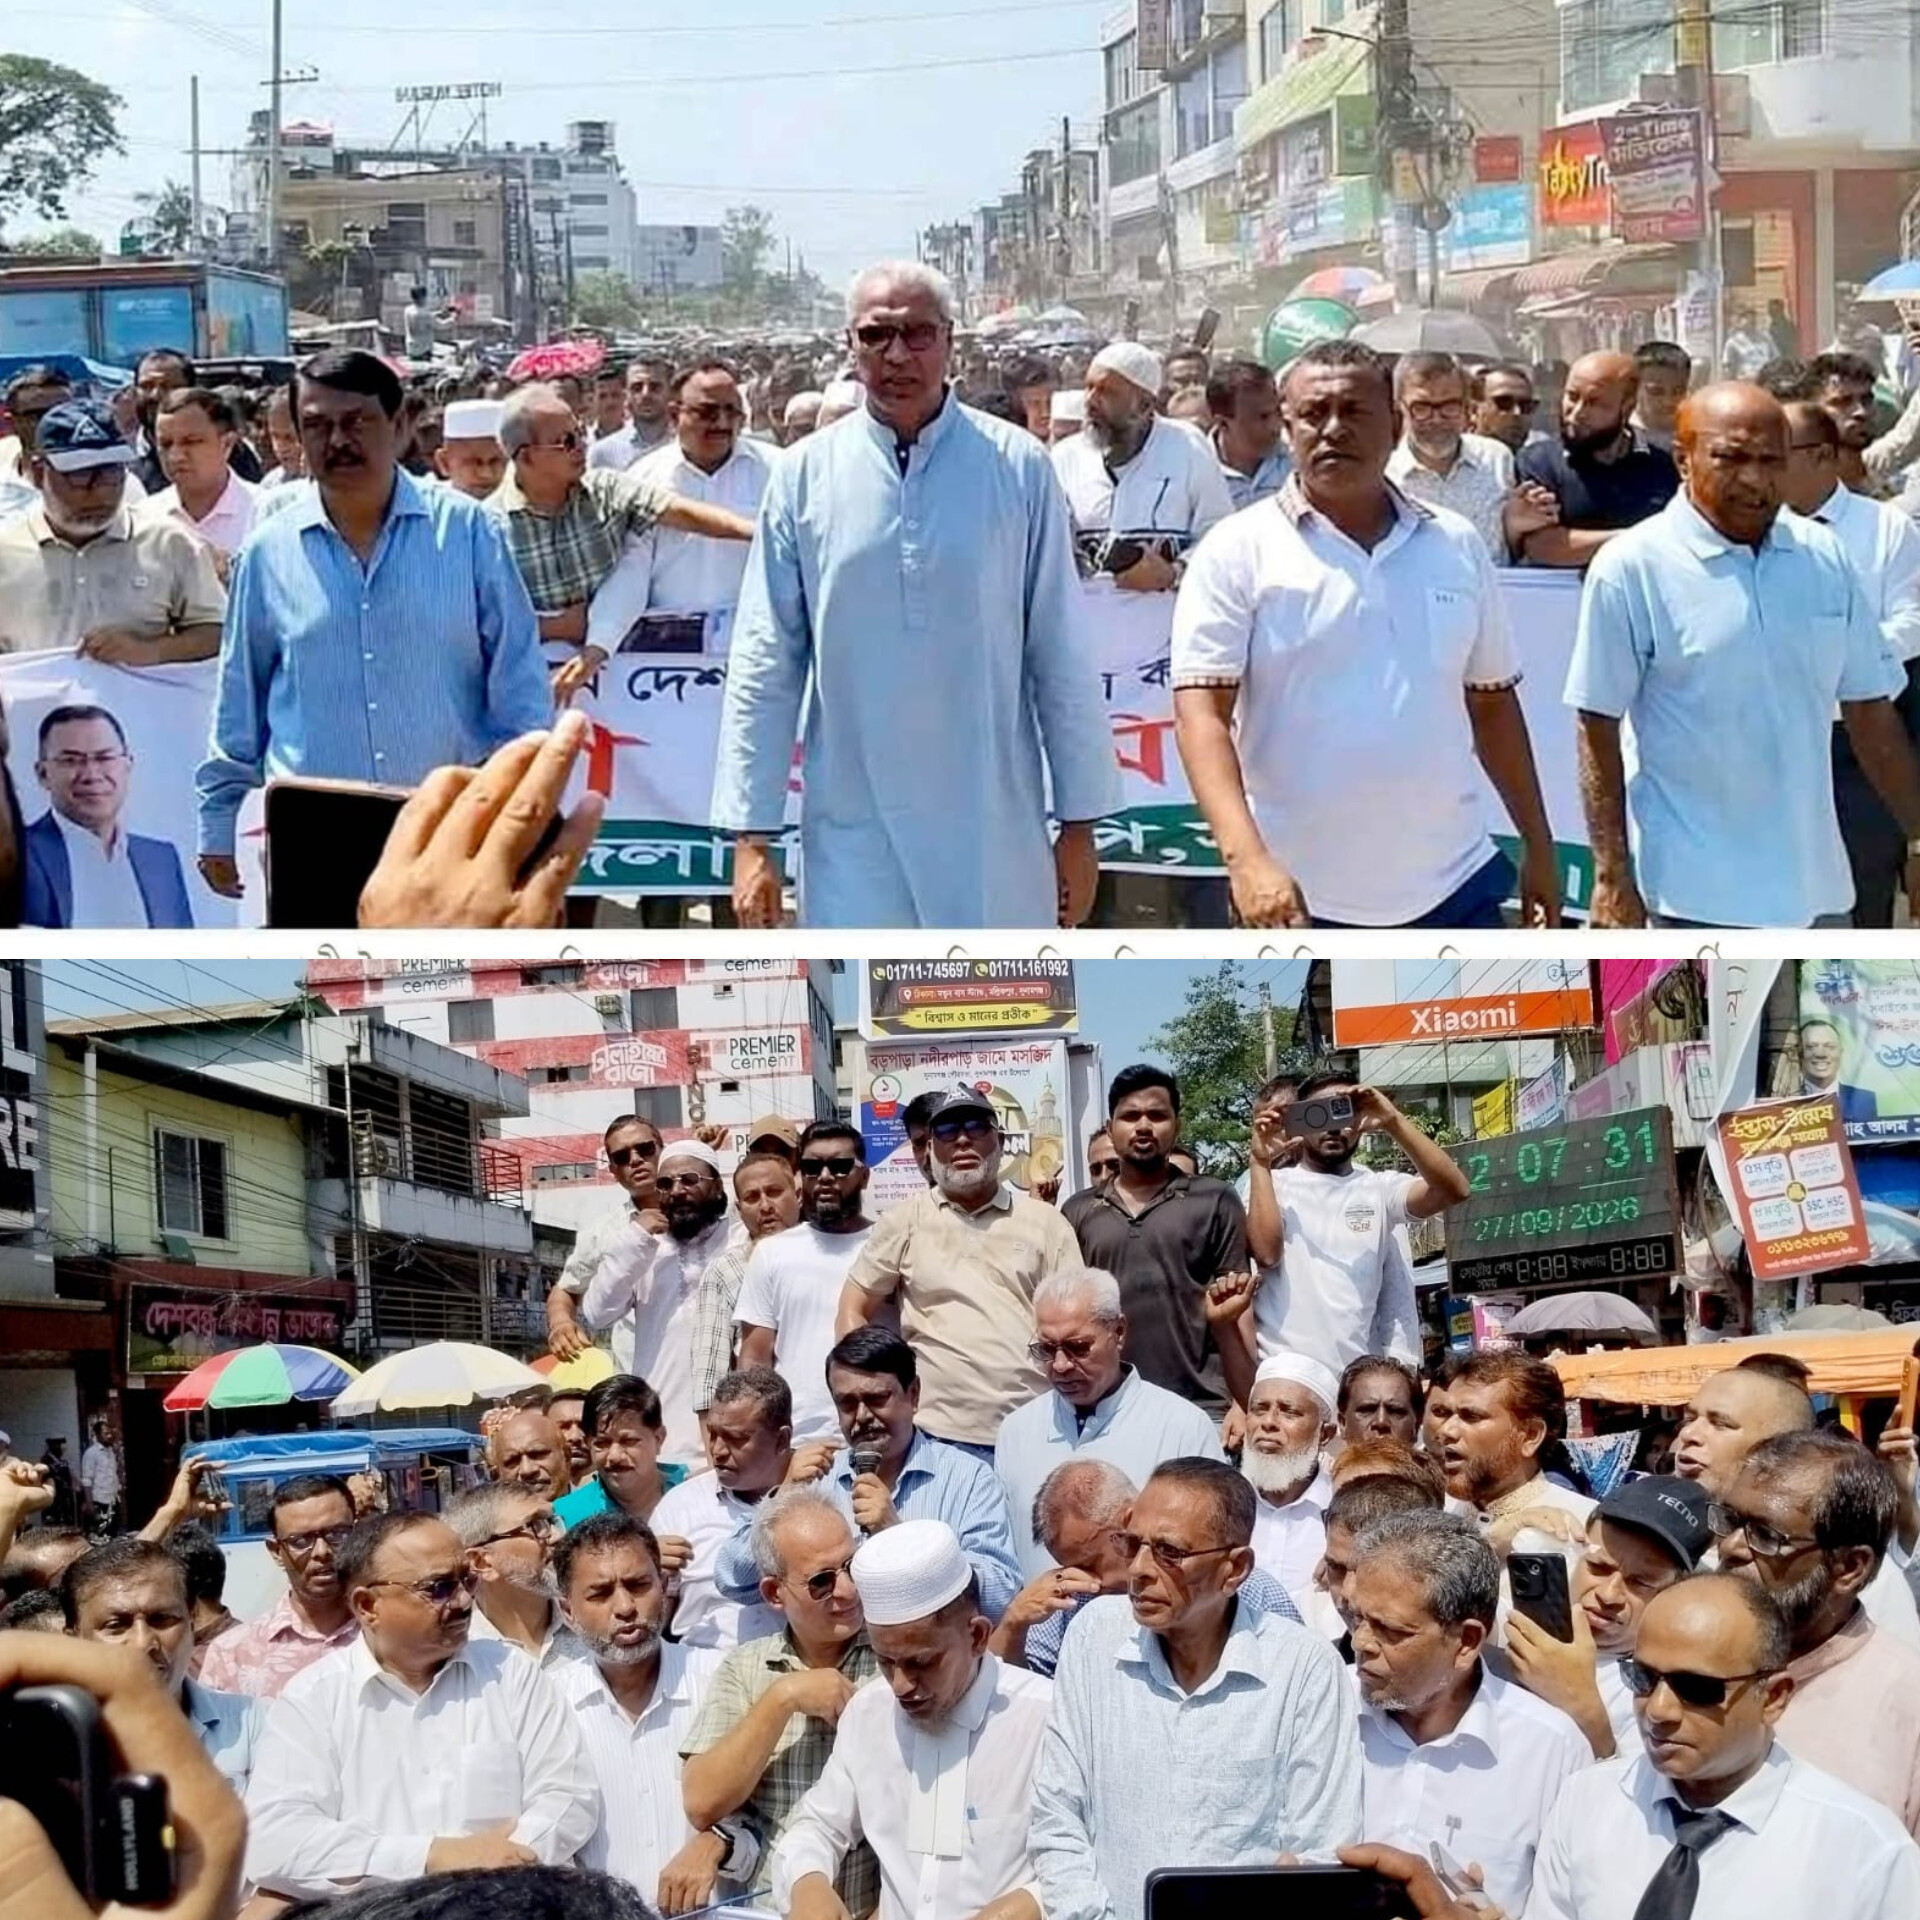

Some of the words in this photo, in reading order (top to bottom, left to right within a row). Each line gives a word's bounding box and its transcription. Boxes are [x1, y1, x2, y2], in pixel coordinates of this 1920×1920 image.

[1541, 139, 1610, 200] TastyTr
[886, 961, 971, 981] 01711-745697
[989, 959, 1069, 978] 01711-161992
[957, 1012, 966, 1022] ও
[968, 1010, 999, 1021] মানের
[1410, 1000, 1517, 1035] Xiaomi
[729, 1034, 796, 1057] PREMIER
[869, 1050, 916, 1071] বড়পাড়া
[976, 1049, 1006, 1066] জামে
[1009, 1046, 1054, 1064] মসজিদ
[1867, 1119, 1909, 1135] আলম
[1474, 1195, 1640, 1241] 27/09/2026
[1656, 1492, 1699, 1529] TECNO
